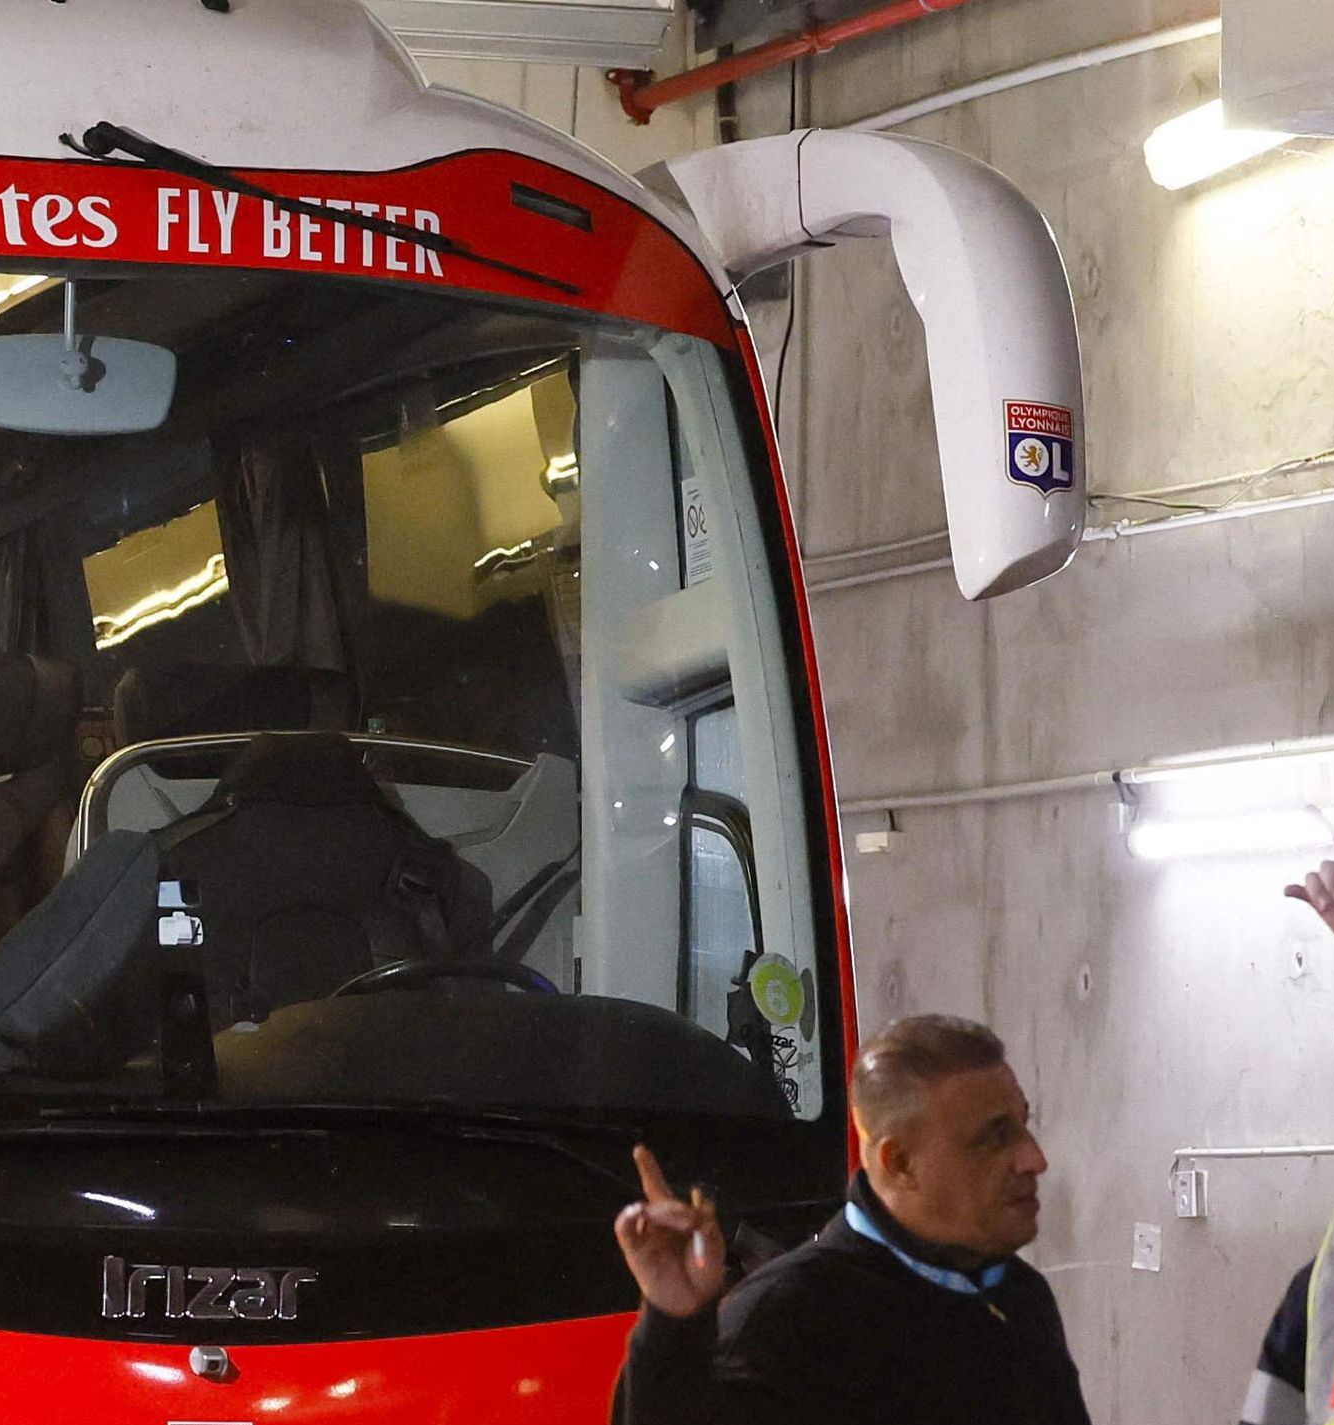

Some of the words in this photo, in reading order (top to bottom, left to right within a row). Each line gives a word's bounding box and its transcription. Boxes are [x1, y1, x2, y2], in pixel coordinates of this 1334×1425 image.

[158, 187, 239, 254] FLY
[263, 196, 444, 277] BETTER
[1010, 406, 1069, 420] OLYMPIQUE
[1012, 417, 1070, 435] LYONNAIS
[1014, 437, 1069, 481] OL
[102, 1255, 318, 1320] Irizar
